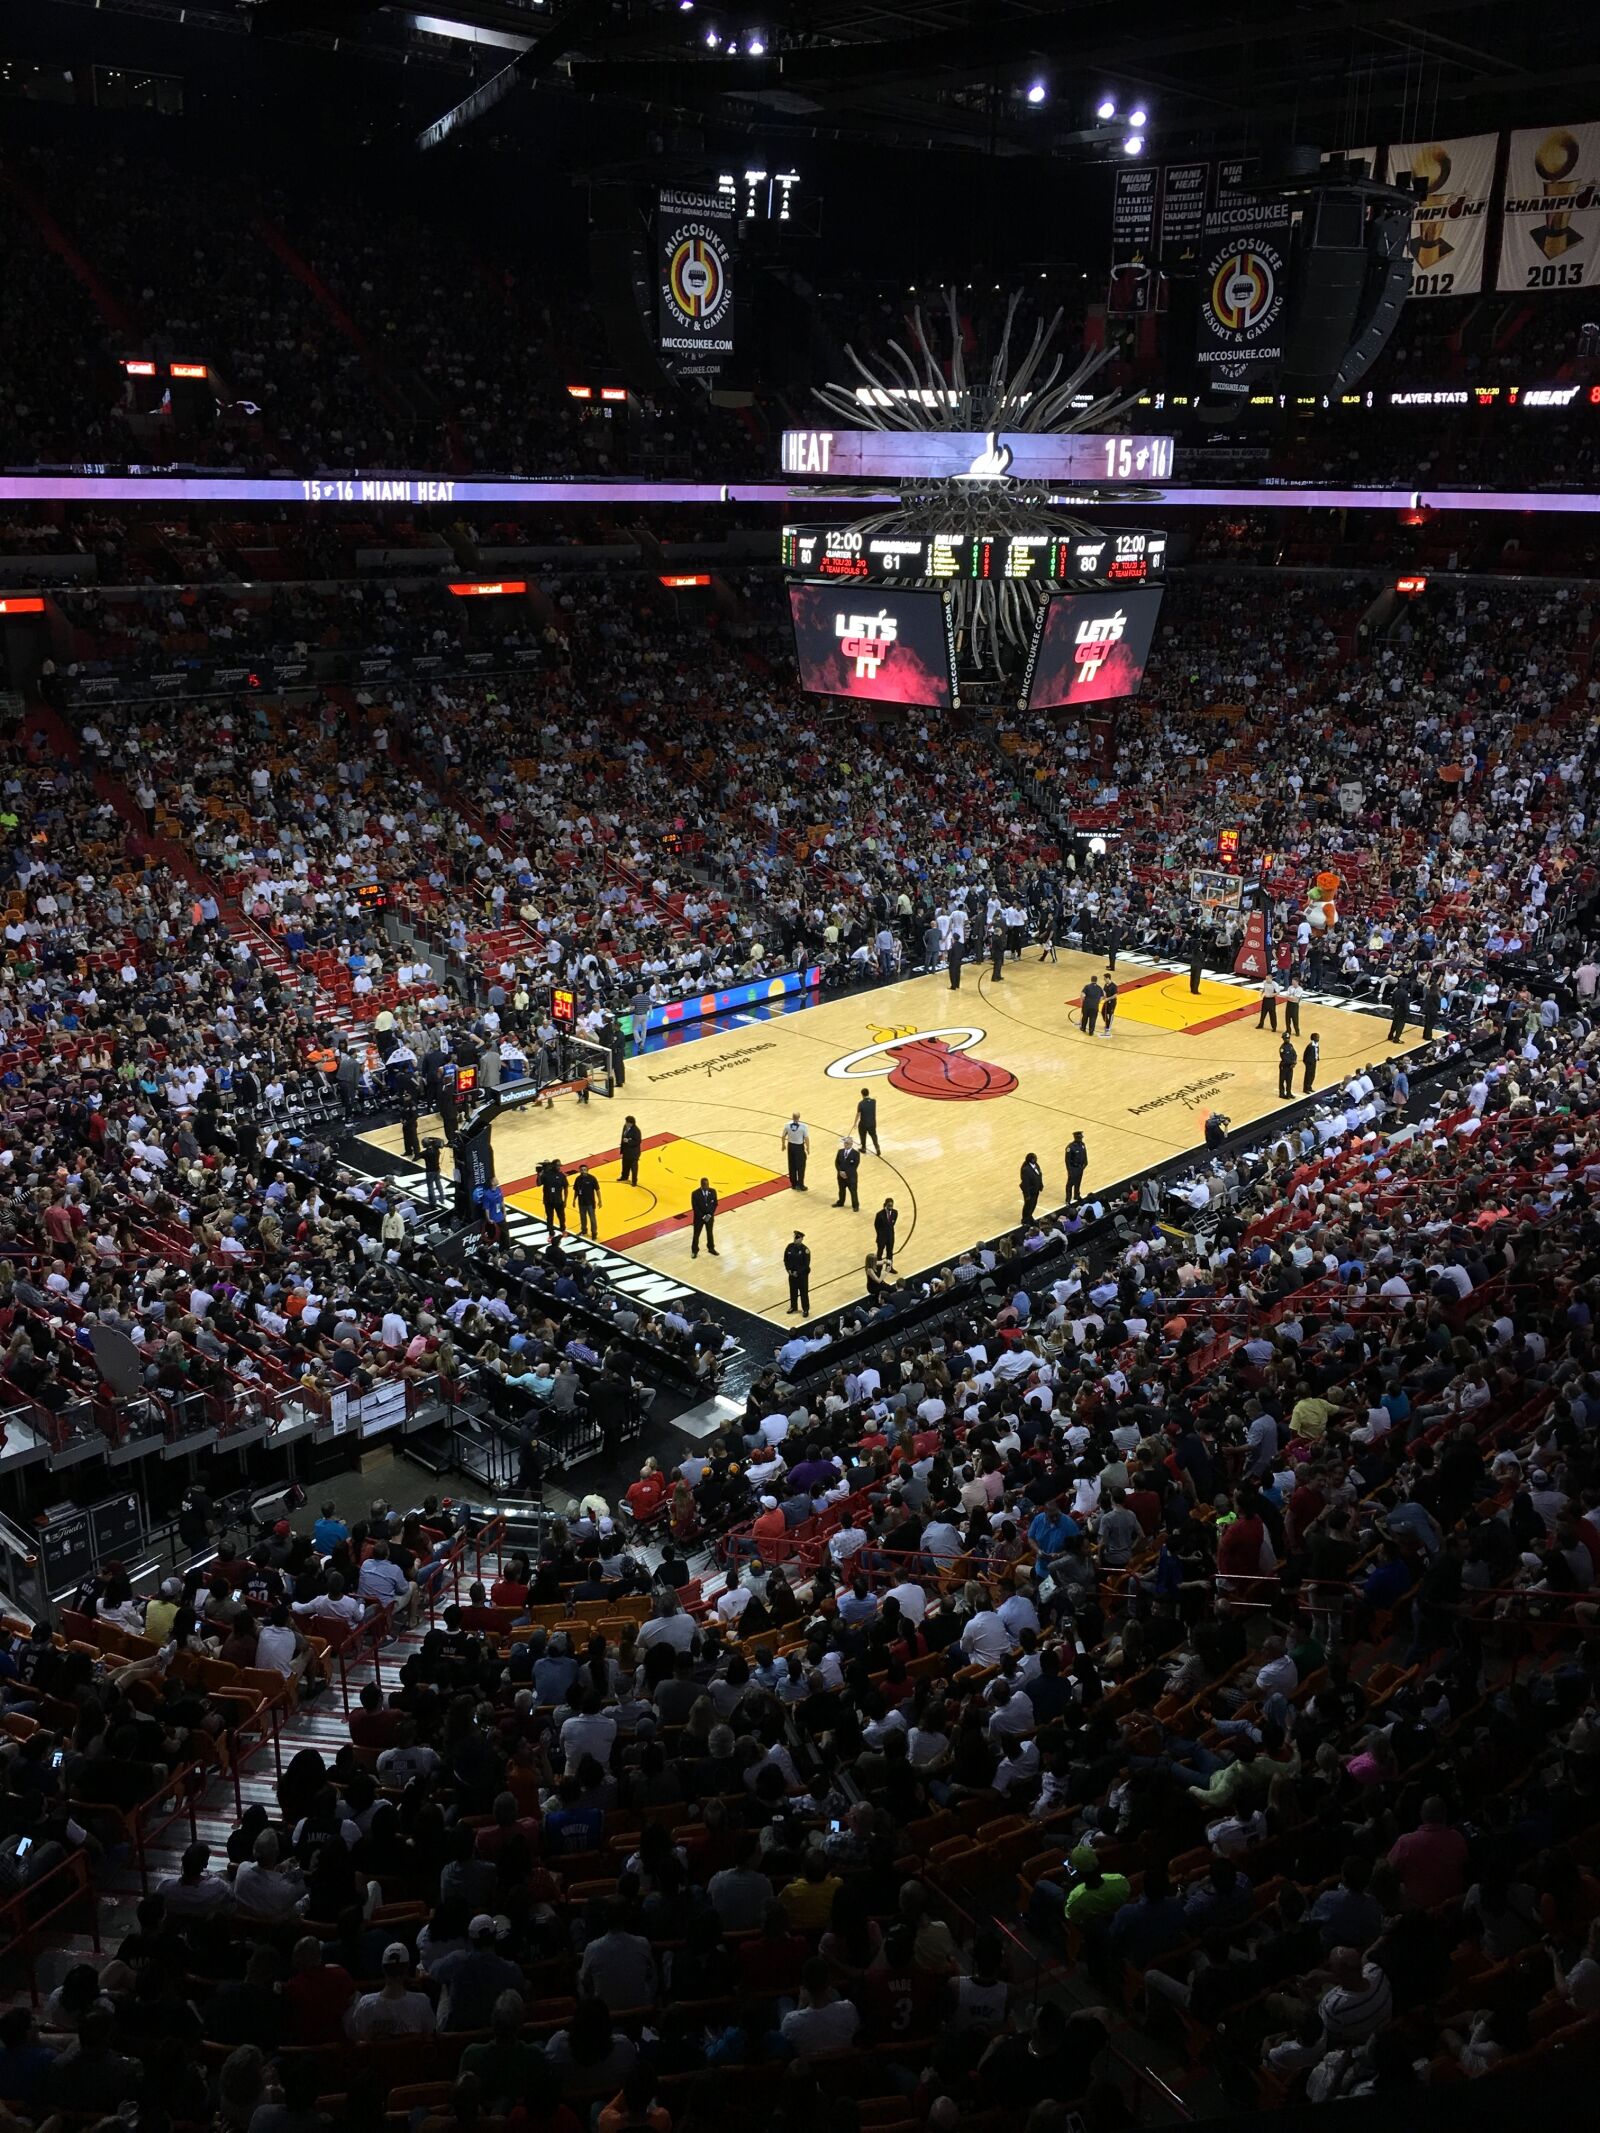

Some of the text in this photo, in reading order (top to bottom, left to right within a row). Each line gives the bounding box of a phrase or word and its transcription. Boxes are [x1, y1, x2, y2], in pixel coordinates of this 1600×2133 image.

[660, 190, 731, 210] MICCOSUKEE
[1206, 204, 1289, 226] MICCOSUKEE
[664, 223, 730, 263] MICCOSUKEE
[1207, 238, 1284, 277] MICCOSUKEE
[1526, 263, 1584, 288] 2013
[662, 284, 733, 332] RESORT & GAMING
[1202, 296, 1284, 342] RESORT & GAMING
[662, 337, 733, 350] MICCOSUKEE.COM
[1198, 348, 1280, 362] MICCOSUKEE.COM
[1250, 396, 1274, 404] ASSTS
[1342, 396, 1360, 404] BLKS
[1391, 392, 1468, 404] PLAYER STATS
[1509, 394, 1516, 404] 0
[1523, 386, 1580, 406] HEAT
[789, 432, 833, 472] HEAT
[1104, 439, 1167, 478] 15 16
[302, 480, 454, 501] 15 16 MIAMI HEAT
[826, 532, 862, 550] 12:00
[1116, 535, 1146, 553] 12:00
[801, 549, 812, 564] 80
[826, 550, 852, 558] QUARTER
[883, 554, 900, 570] 61
[1080, 556, 1098, 572] 80
[1115, 554, 1138, 562] QUARTER
[841, 566, 860, 574] FOULS
[836, 609, 898, 641] LET'S
[1075, 608, 1128, 644] LET'S
[841, 636, 890, 660] GET
[945, 604, 958, 696] MICCOSUKEE.COM
[1022, 606, 1046, 698] MICCOSUKEE.COM
[1074, 640, 1115, 664] GET
[856, 656, 880, 678] IT
[1078, 659, 1103, 682] IT
[1221, 839, 1236, 850] 24
[555, 990, 573, 1003] 12:00
[554, 1001, 572, 1021] 24
[648, 1042, 777, 1082] AmericanAirlines
[703, 1057, 752, 1078] Arena
[460, 1068, 474, 1078] 12:00
[460, 1078, 472, 1089] 24
[500, 1088, 536, 1103] bahamas
[1128, 1072, 1236, 1116] AmericanAirlines
[1180, 1088, 1221, 1110] Arena
[24, 1666, 34, 1684] 3
[306, 1832, 333, 1843] JAMES
[888, 1978, 912, 1993] WADE
[890, 1998, 913, 2032] 3
